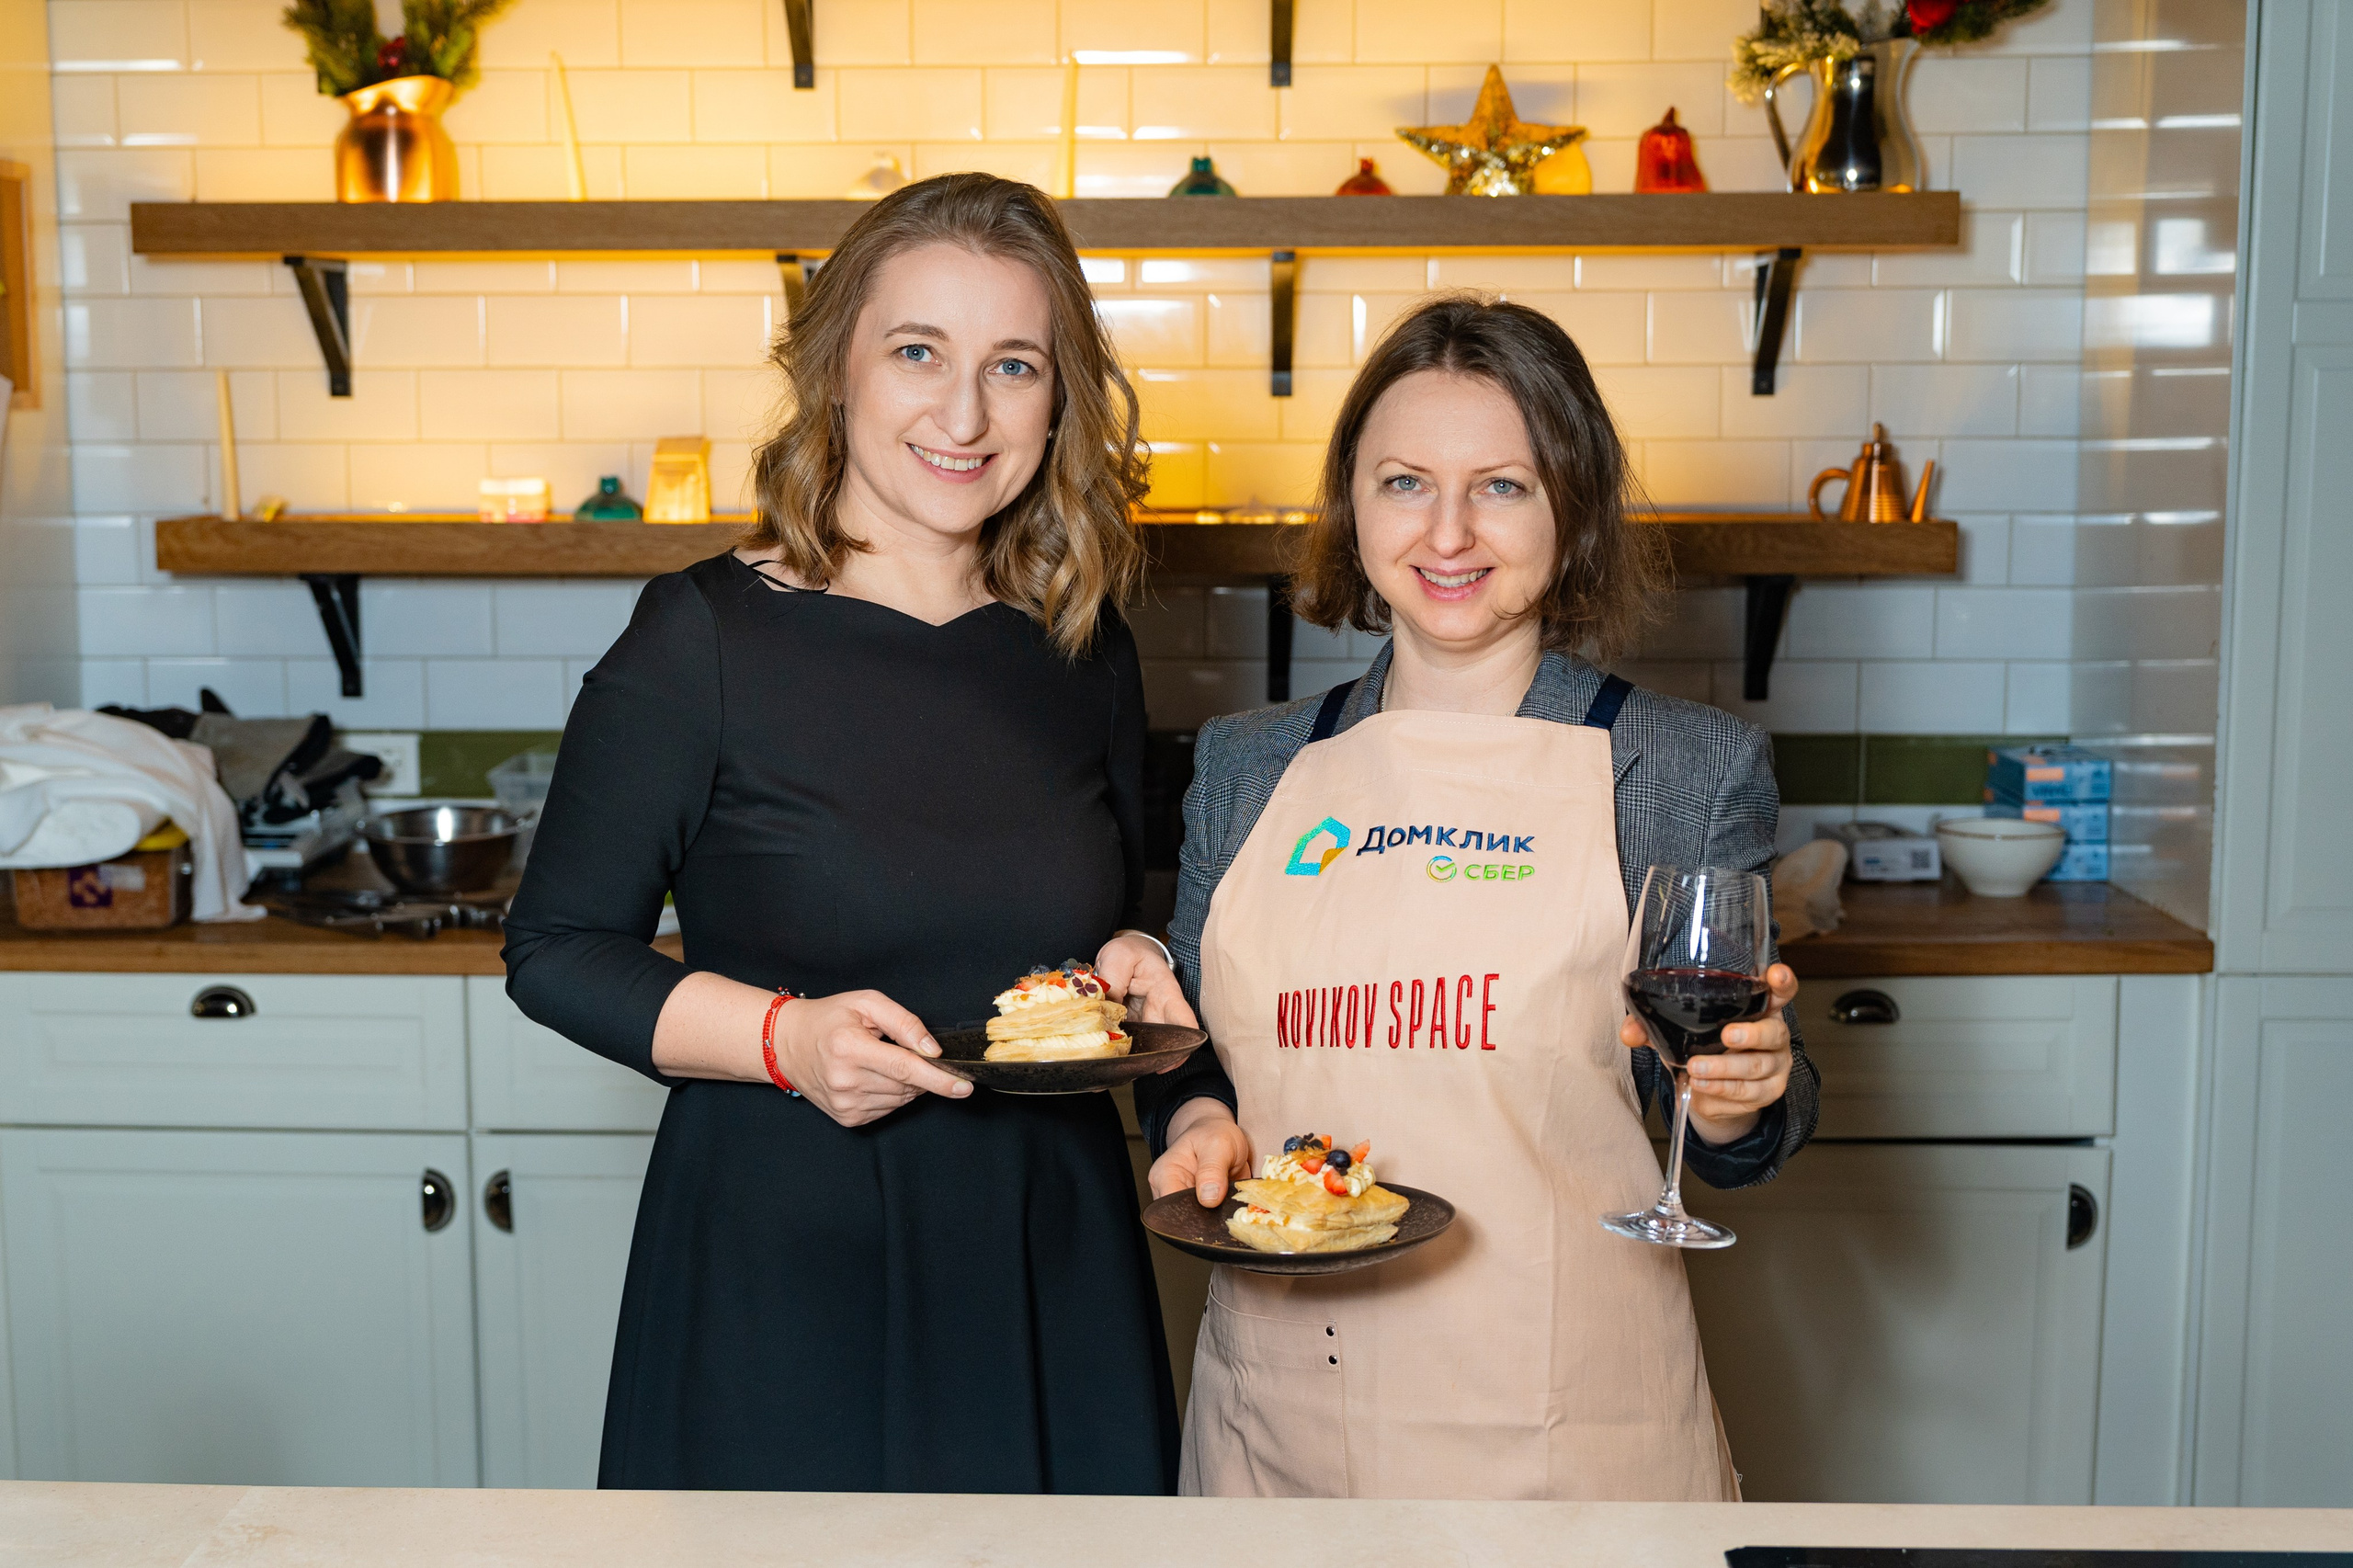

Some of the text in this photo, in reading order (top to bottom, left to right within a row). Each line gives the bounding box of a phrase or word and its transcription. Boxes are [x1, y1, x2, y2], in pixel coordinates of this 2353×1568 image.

[1464, 864, 1535, 881] СБЕР
[1278, 973, 1499, 1050] NOVIKOV SPACE
